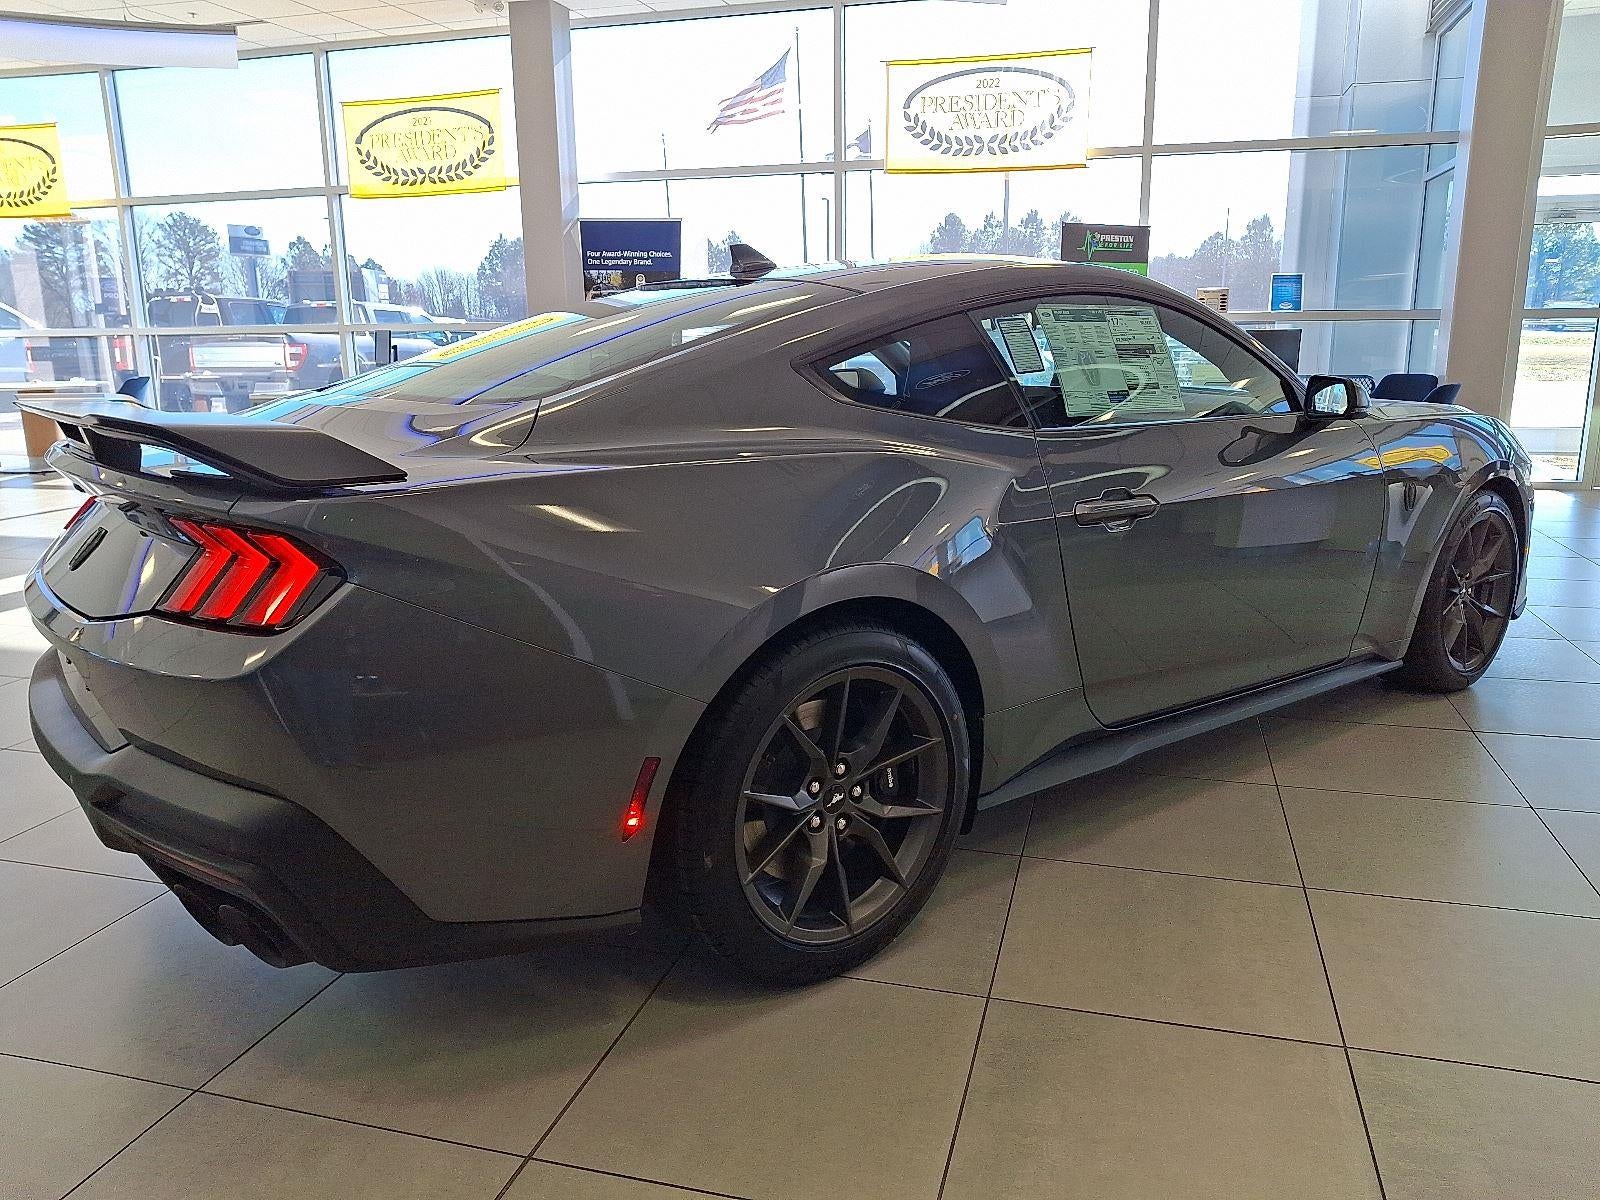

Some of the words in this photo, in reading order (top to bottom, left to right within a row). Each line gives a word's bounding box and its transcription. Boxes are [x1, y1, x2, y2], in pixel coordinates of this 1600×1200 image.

[975, 78, 1001, 89] 2022
[949, 109, 1025, 131] AWARD
[397, 142, 457, 164] AWARD
[1100, 234, 1134, 243] PRESTON
[602, 250, 648, 259] Award-Winning
[648, 250, 672, 258] Choices.
[601, 258, 632, 267] Legendary
[633, 258, 653, 266] Brand.
